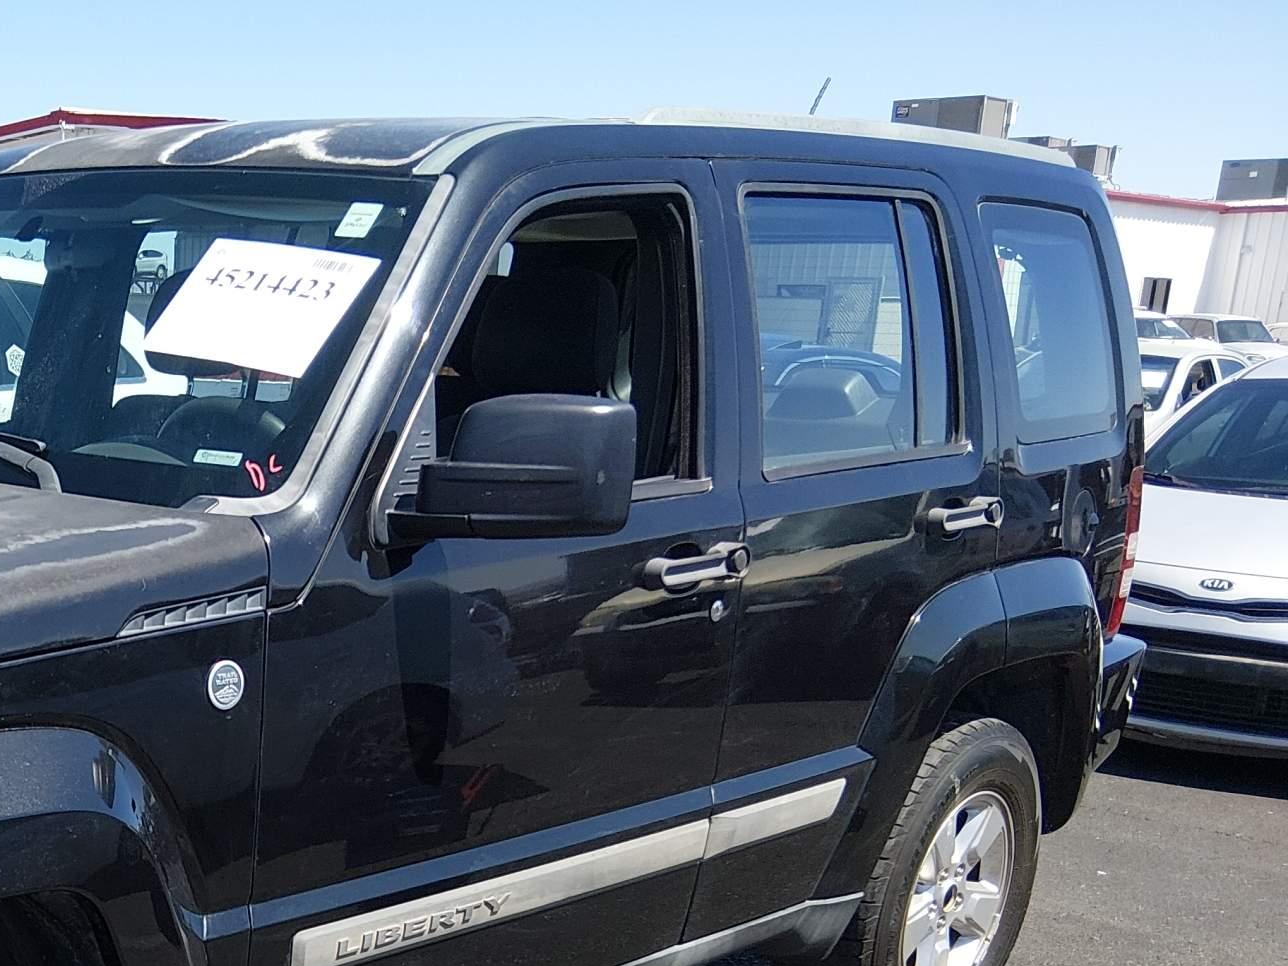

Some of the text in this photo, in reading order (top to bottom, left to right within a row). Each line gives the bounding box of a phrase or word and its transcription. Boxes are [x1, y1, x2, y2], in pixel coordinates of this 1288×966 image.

[206, 267, 336, 301] 45214423
[1203, 579, 1229, 590] KIA
[335, 892, 511, 961] LIBERTY
